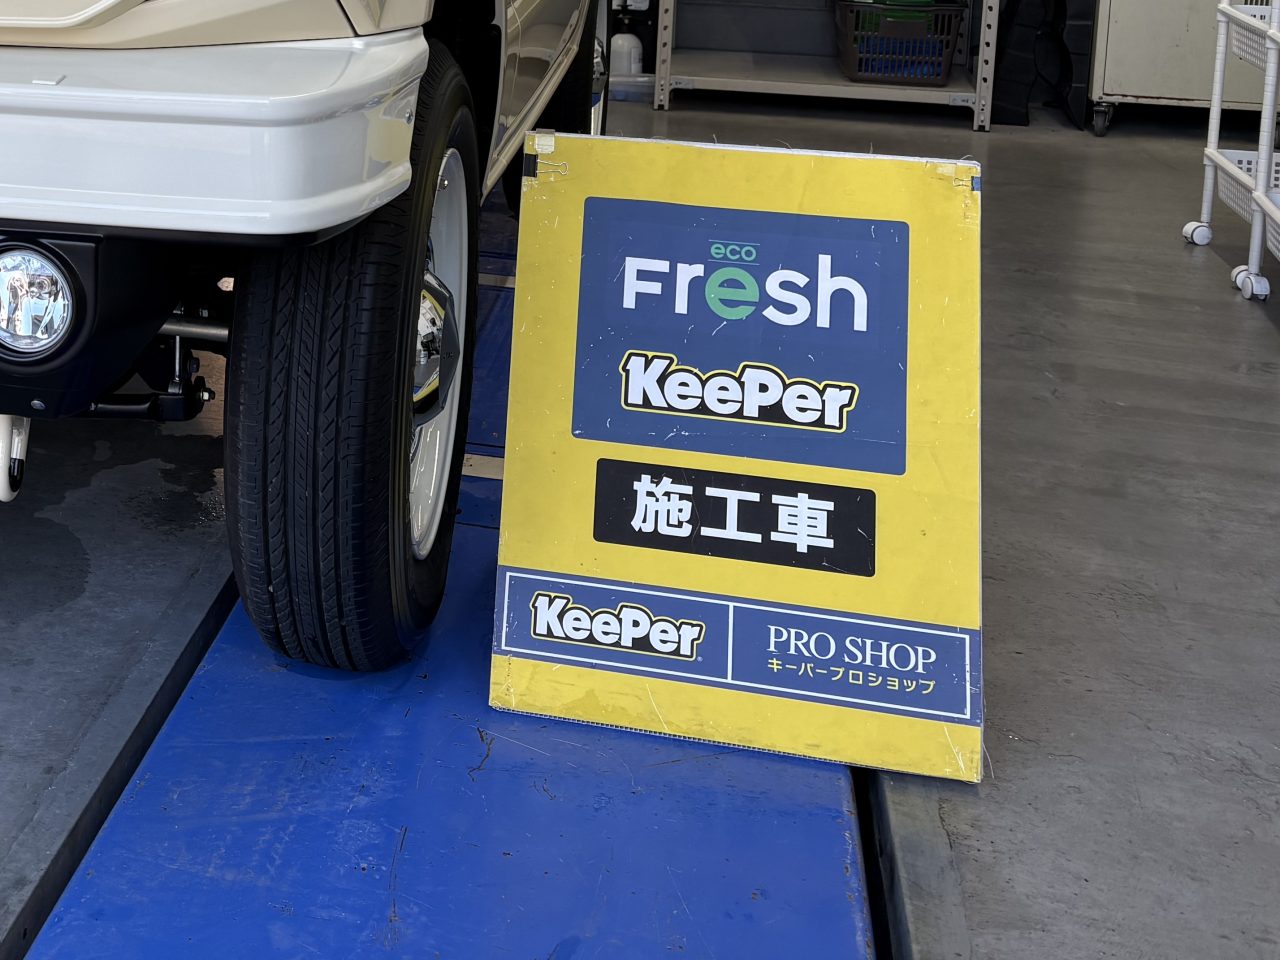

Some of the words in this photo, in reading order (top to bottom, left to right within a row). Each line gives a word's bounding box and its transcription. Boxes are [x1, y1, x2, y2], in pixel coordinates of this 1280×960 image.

[710, 243, 757, 262] eco
[622, 253, 868, 332] Fresh
[624, 353, 854, 429] KeePer
[630, 474, 836, 553] 施工車
[532, 592, 704, 660] KeePer
[766, 624, 837, 660] PRO
[843, 636, 937, 674] SHOP
[767, 657, 936, 695] キーパープロショップ
